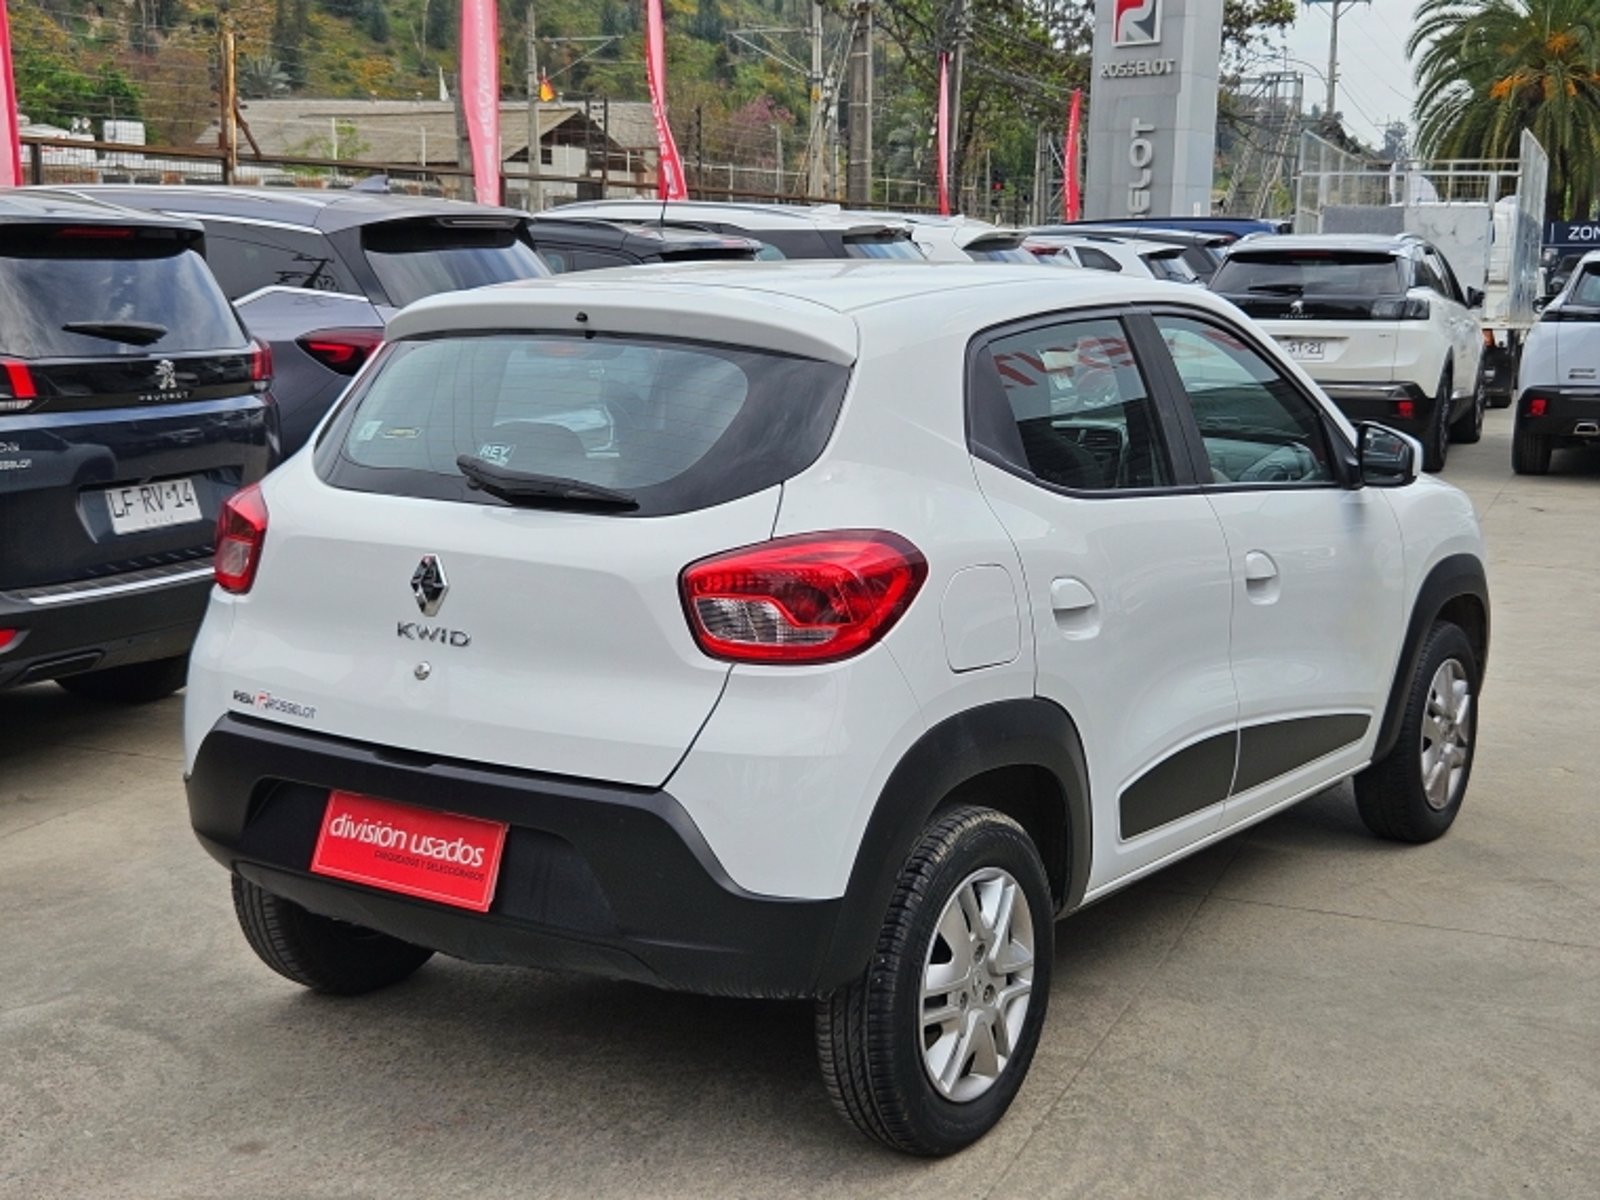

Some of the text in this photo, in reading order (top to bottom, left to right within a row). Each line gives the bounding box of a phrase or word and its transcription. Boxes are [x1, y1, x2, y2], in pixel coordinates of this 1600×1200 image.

[1101, 59, 1175, 77] ROSSELOT
[397, 621, 472, 648] KWID
[329, 813, 485, 867] división usados
